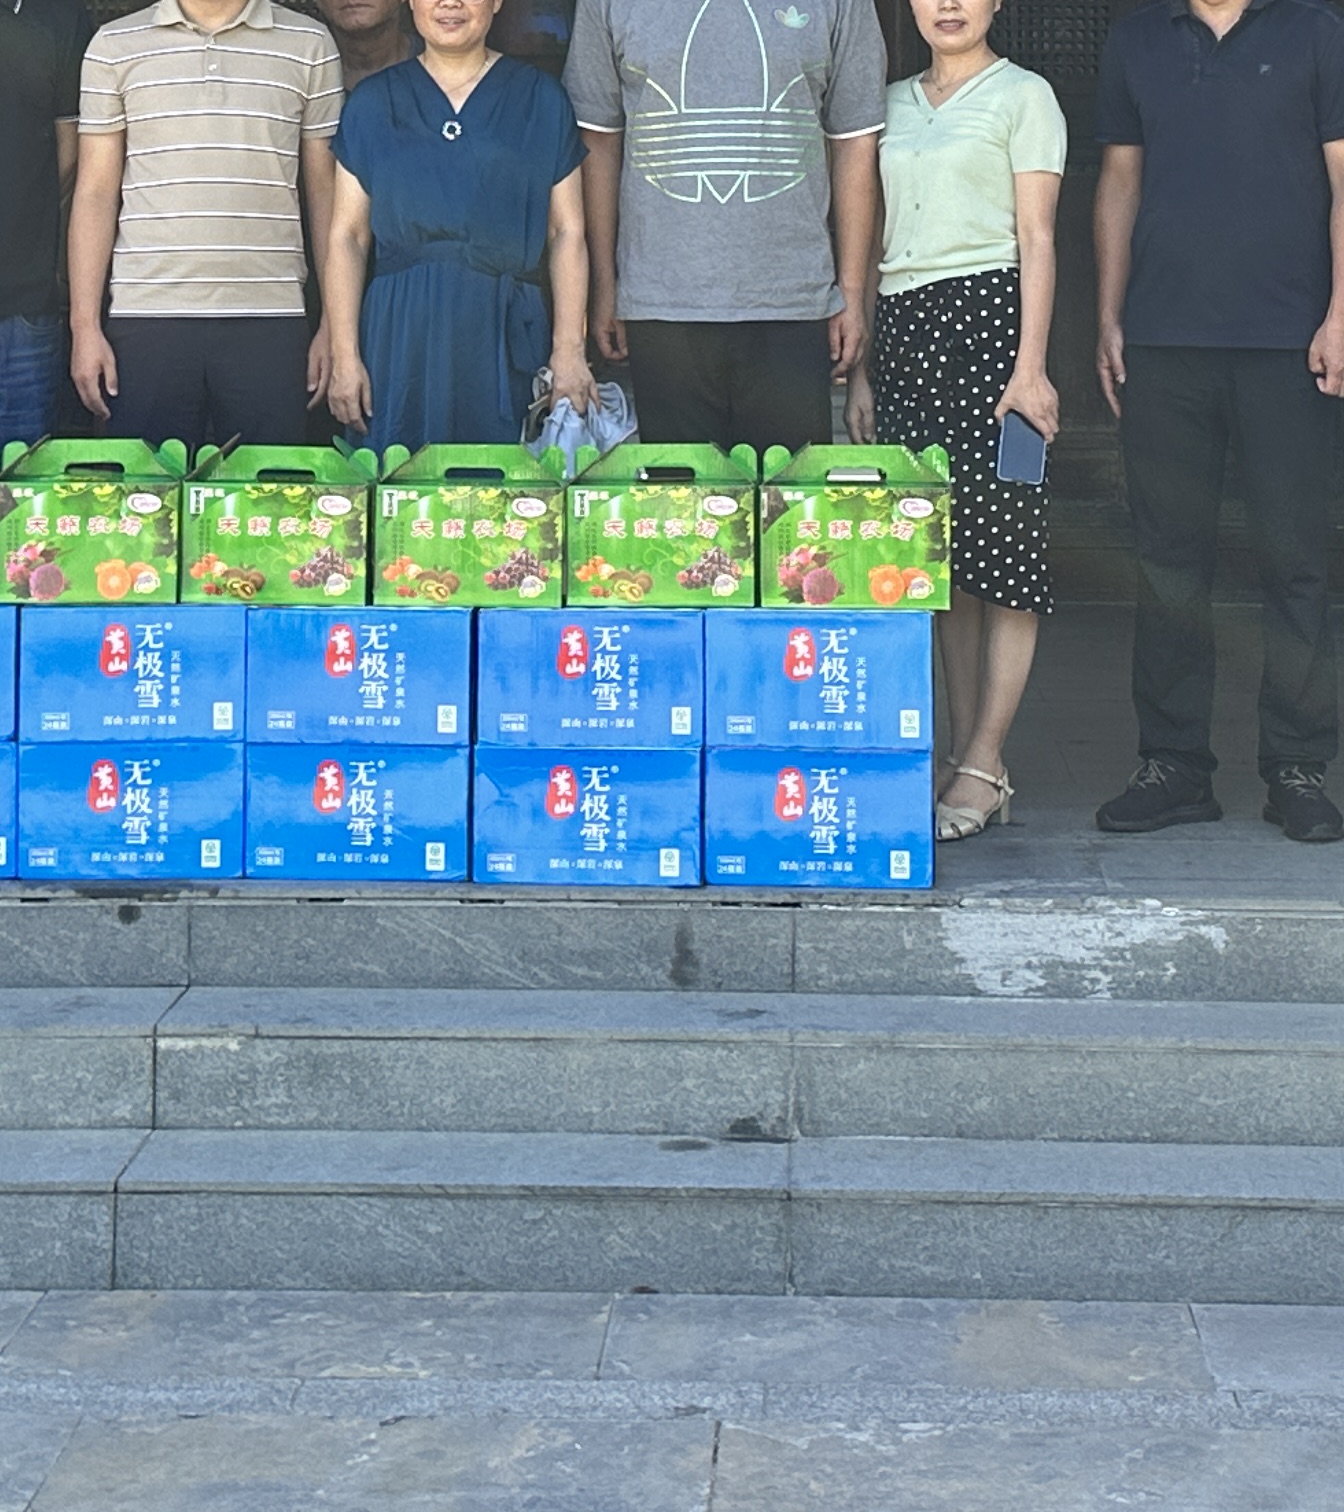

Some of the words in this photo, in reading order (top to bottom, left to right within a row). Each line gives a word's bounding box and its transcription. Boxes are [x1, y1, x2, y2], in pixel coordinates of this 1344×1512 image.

[106, 628, 128, 673] 黄山
[133, 623, 165, 708] 无极雪
[330, 628, 353, 673] 黄山
[358, 624, 390, 709] 无极雪
[562, 631, 586, 675] 黄山
[591, 626, 623, 711] 无极雪
[790, 633, 813, 677] 黄山
[819, 628, 850, 714] 无极雪
[93, 765, 116, 809] 黄山
[122, 759, 153, 845] 无极雪
[319, 765, 342, 810] 黄山
[347, 760, 378, 847] 无极雪
[552, 770, 575, 815] 黄山
[580, 766, 611, 852] 无极雪
[779, 772, 803, 818] 黄山
[809, 768, 840, 854] 无极雪
